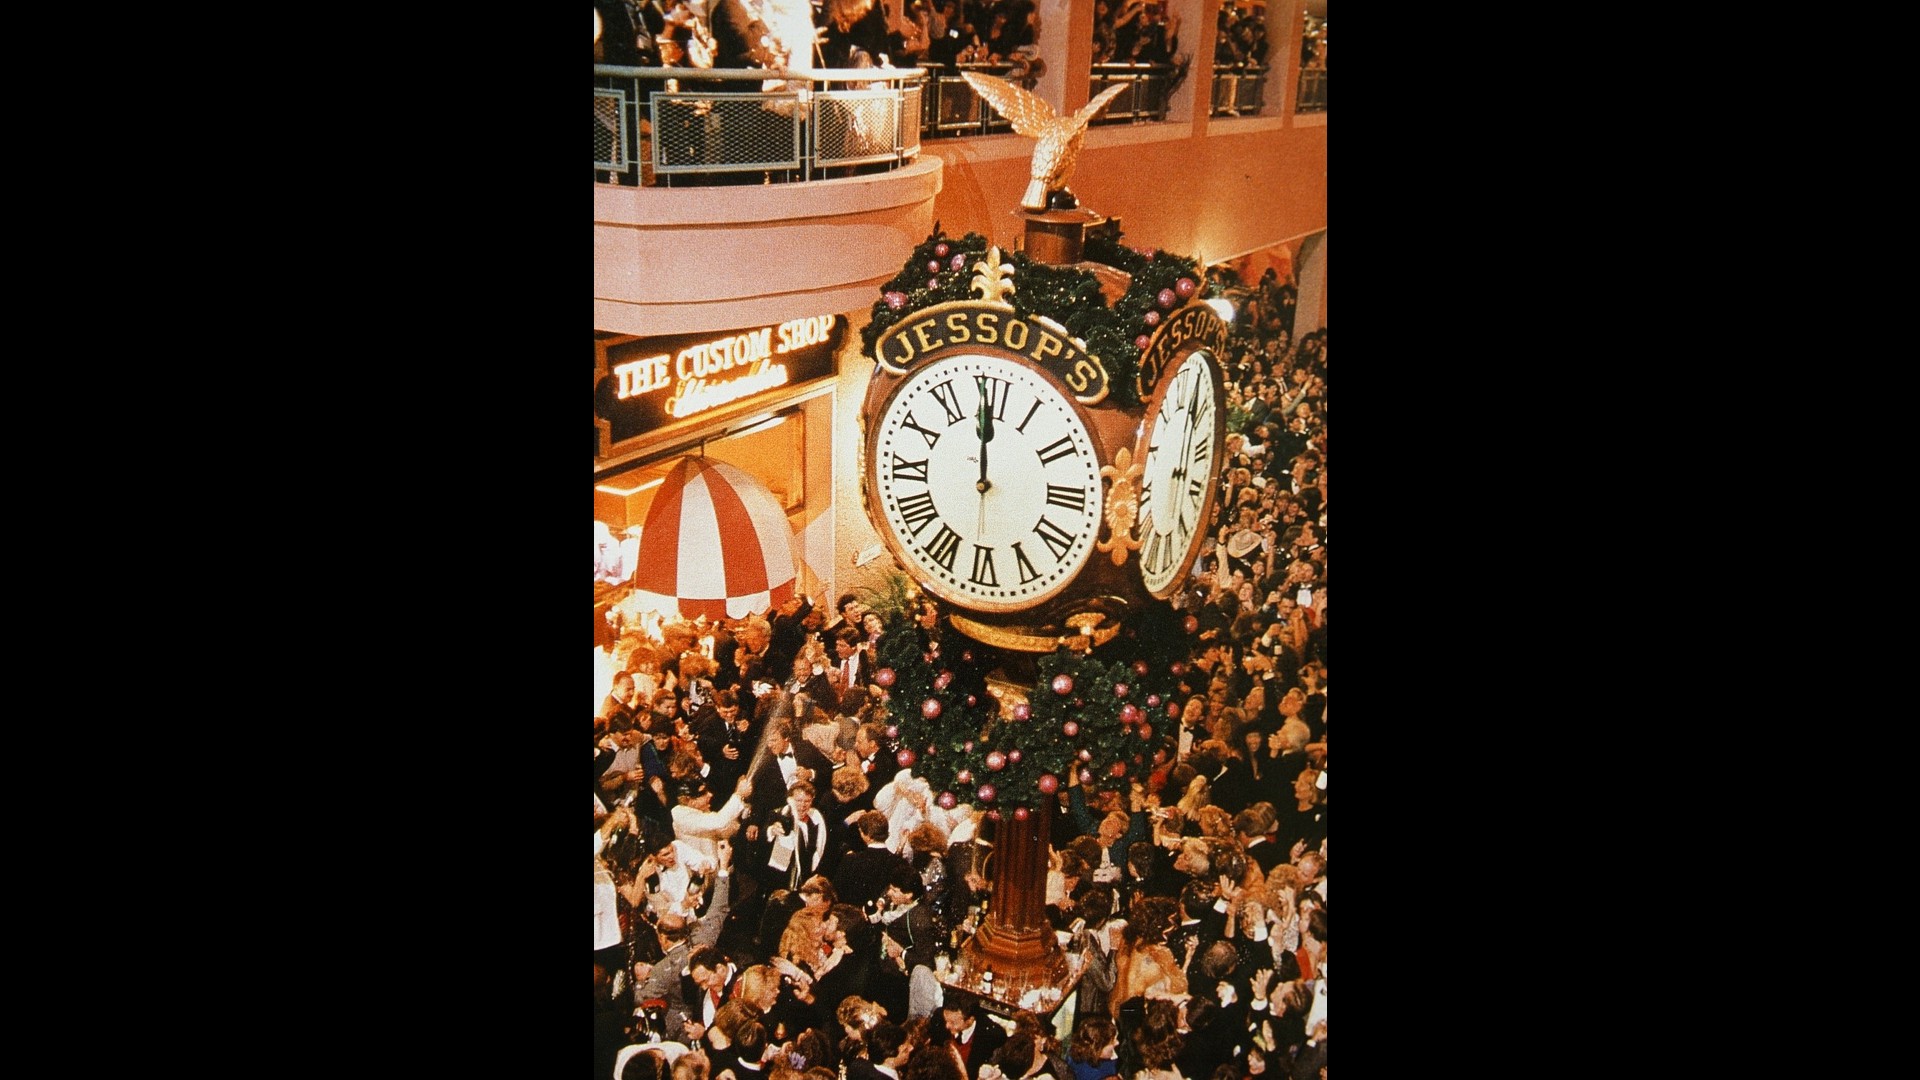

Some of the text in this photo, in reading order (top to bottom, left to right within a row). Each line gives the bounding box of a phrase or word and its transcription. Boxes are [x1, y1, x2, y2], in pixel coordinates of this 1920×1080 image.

[613, 354, 672, 400] THE
[675, 327, 773, 382] CUSTOM
[776, 313, 837, 354] SHOP
[895, 312, 1099, 392] JESSOP'S
[927, 379, 967, 427] XI
[1014, 395, 1045, 435] I
[900, 409, 941, 450] X
[1035, 432, 1079, 468] II
[892, 451, 929, 484] IX
[896, 489, 940, 539] VIII
[1046, 482, 1086, 515] III
[921, 522, 963, 574] VII
[1032, 514, 1078, 563] IV
[968, 543, 1001, 587] VI
[1010, 541, 1043, 585] V
